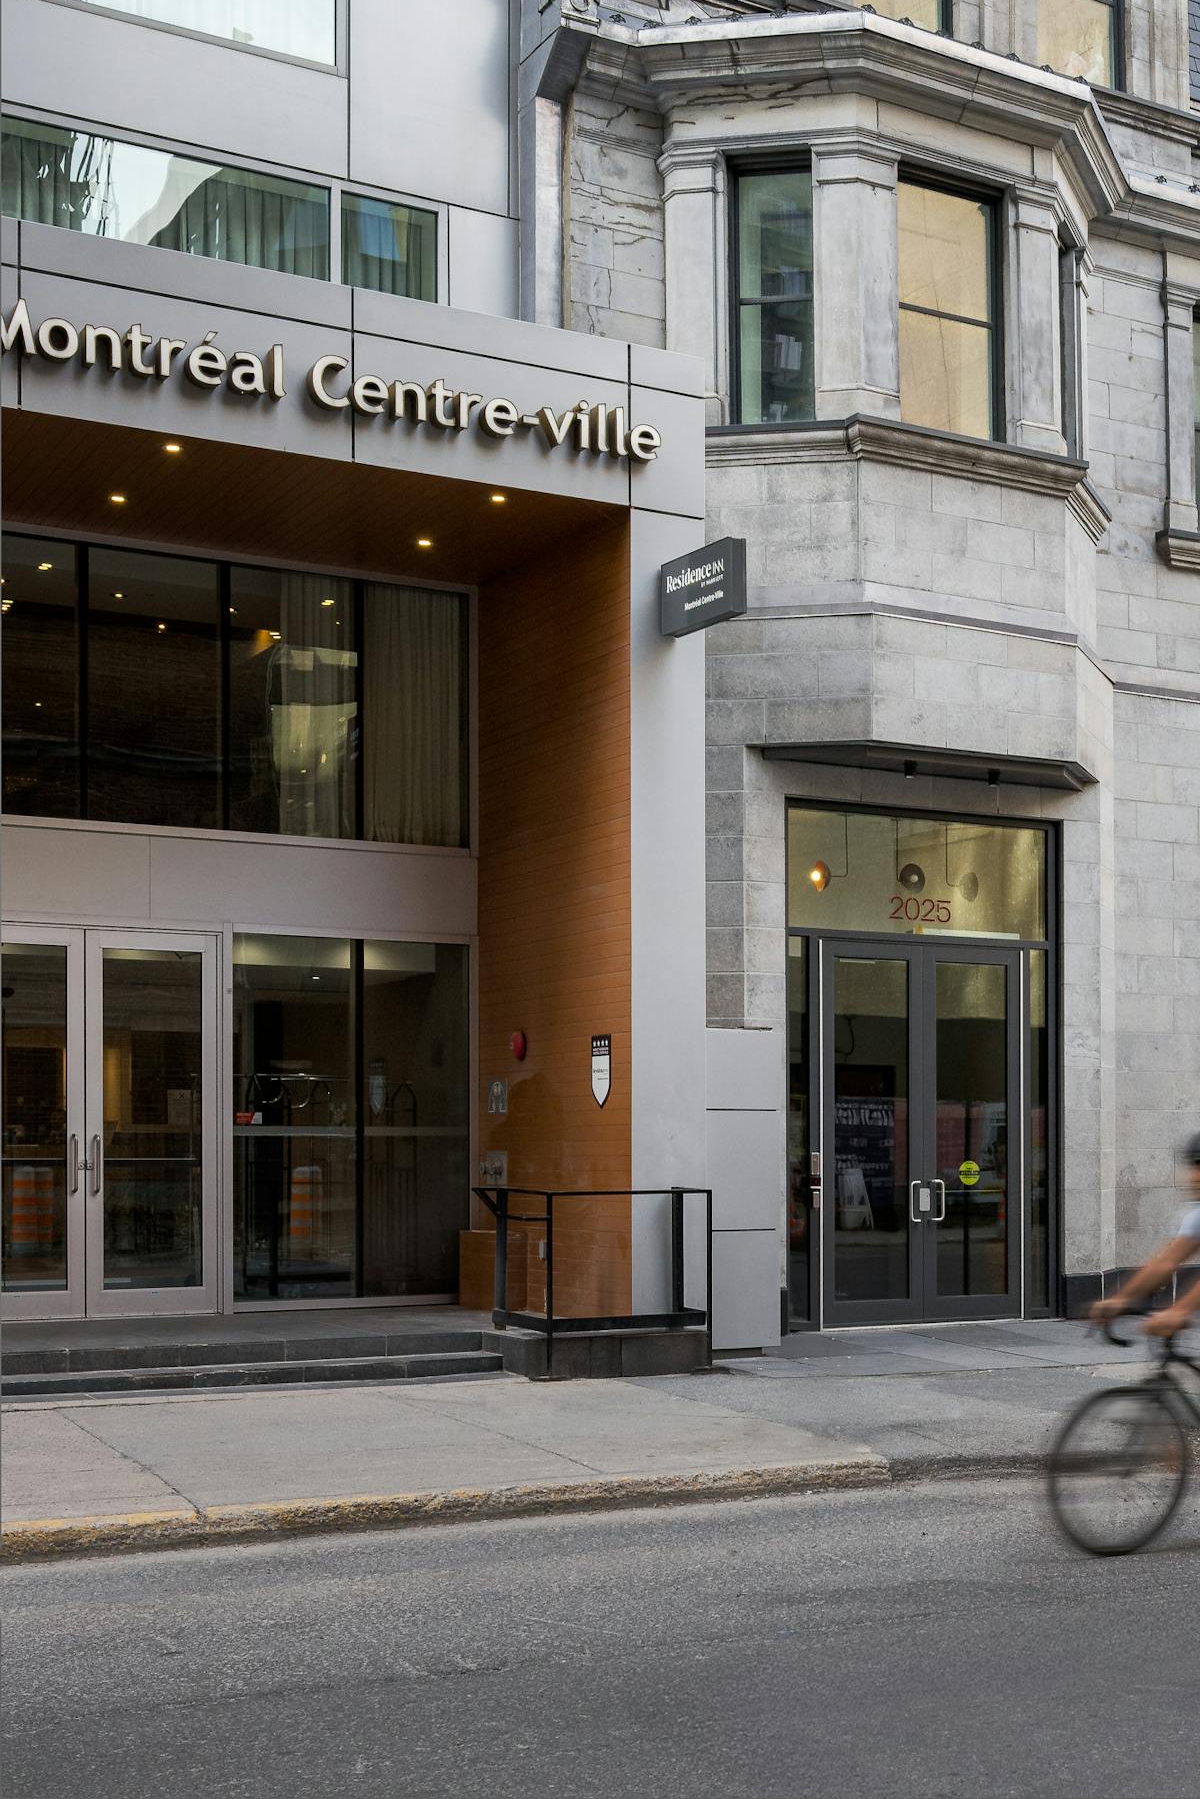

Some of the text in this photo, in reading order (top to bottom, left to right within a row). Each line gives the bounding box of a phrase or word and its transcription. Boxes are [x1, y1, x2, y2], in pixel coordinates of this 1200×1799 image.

[1, 298, 662, 462] Montréal Centre-ville
[666, 558, 725, 593] Residence INN
[685, 589, 724, 611] Montréal Centre-Ville
[889, 896, 951, 923] 2025
